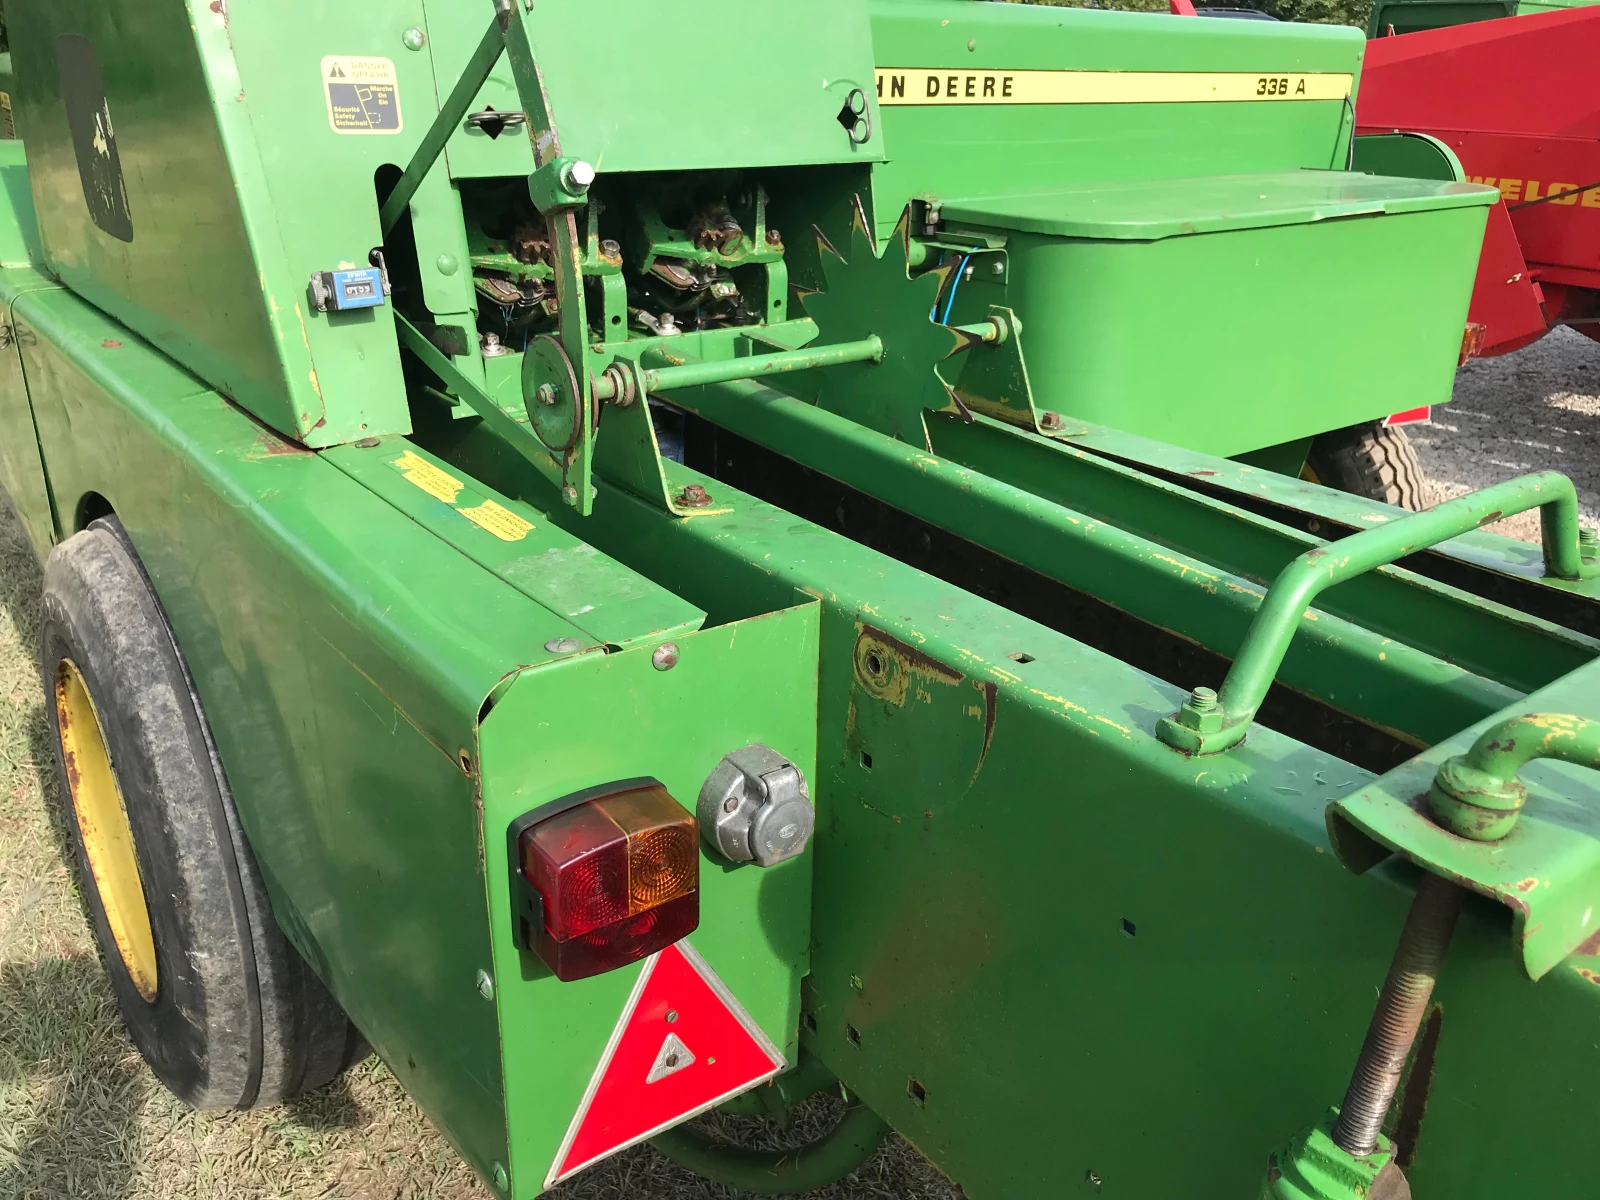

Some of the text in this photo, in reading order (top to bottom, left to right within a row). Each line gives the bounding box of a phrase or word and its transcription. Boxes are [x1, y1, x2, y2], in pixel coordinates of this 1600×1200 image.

[351, 62, 388, 70] DANGER
[352, 71, 389, 79] GEFAHR
[926, 76, 1013, 98] DEERE
[1257, 78, 1305, 95] 336 A
